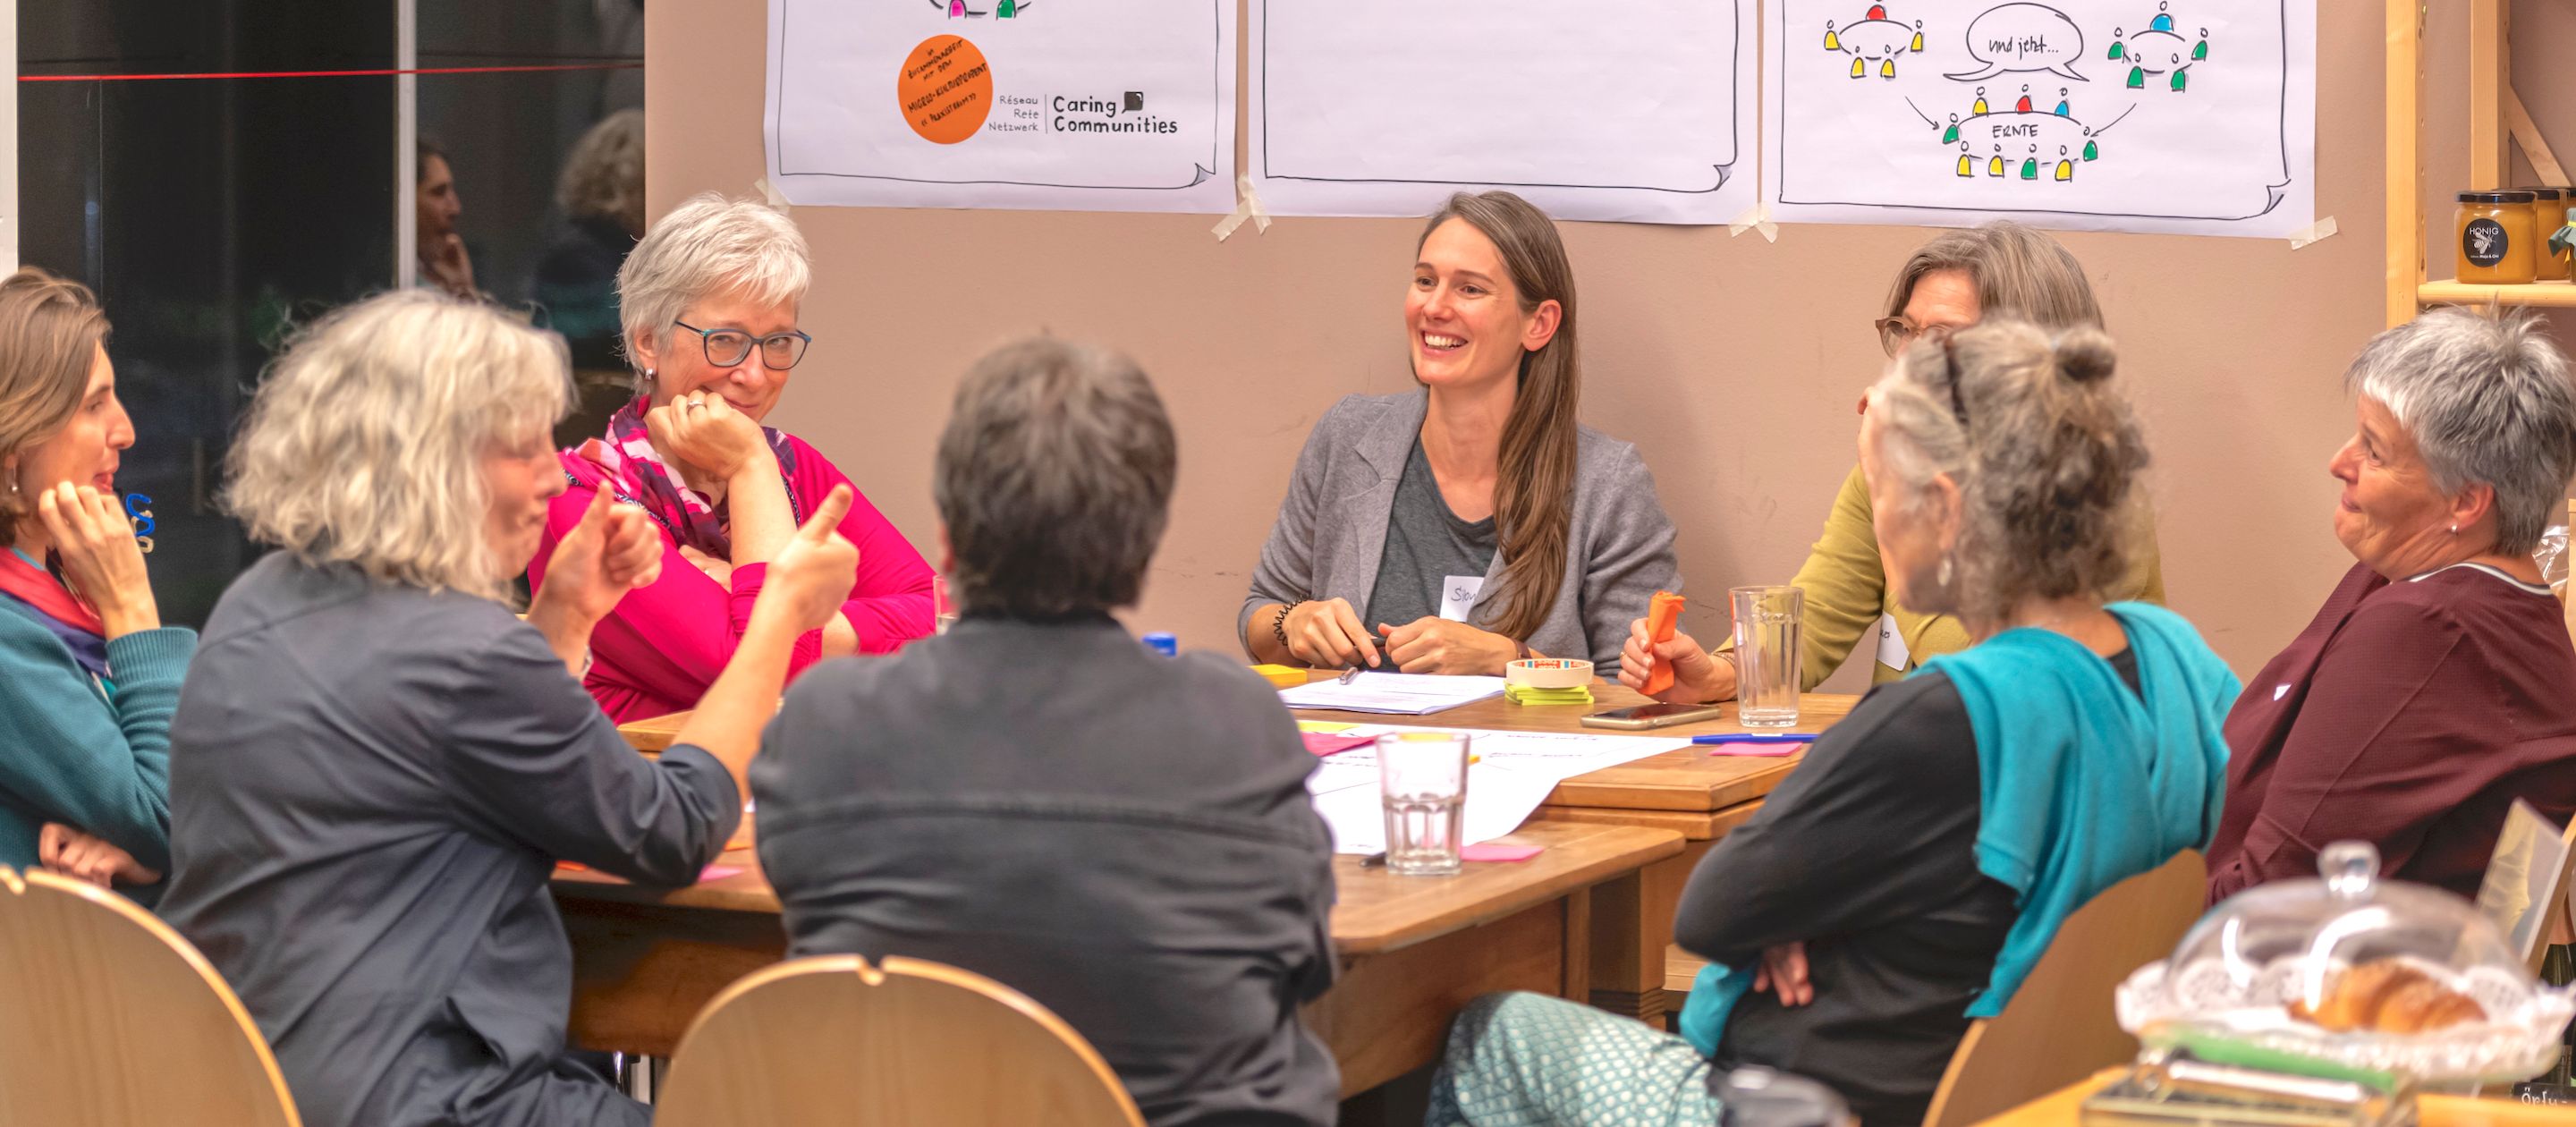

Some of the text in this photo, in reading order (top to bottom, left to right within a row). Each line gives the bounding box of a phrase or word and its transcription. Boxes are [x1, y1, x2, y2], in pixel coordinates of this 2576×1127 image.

[1988, 35, 2013, 54] und
[999, 96, 1038, 106] Réseau
[1053, 96, 1117, 118] Caring
[1013, 108, 1039, 119] Rete
[988, 122, 1038, 132] Netzwerk
[1054, 115, 1178, 133] Communities
[1992, 124, 2038, 139] ERNTE
[2469, 227, 2499, 235] HONIG
